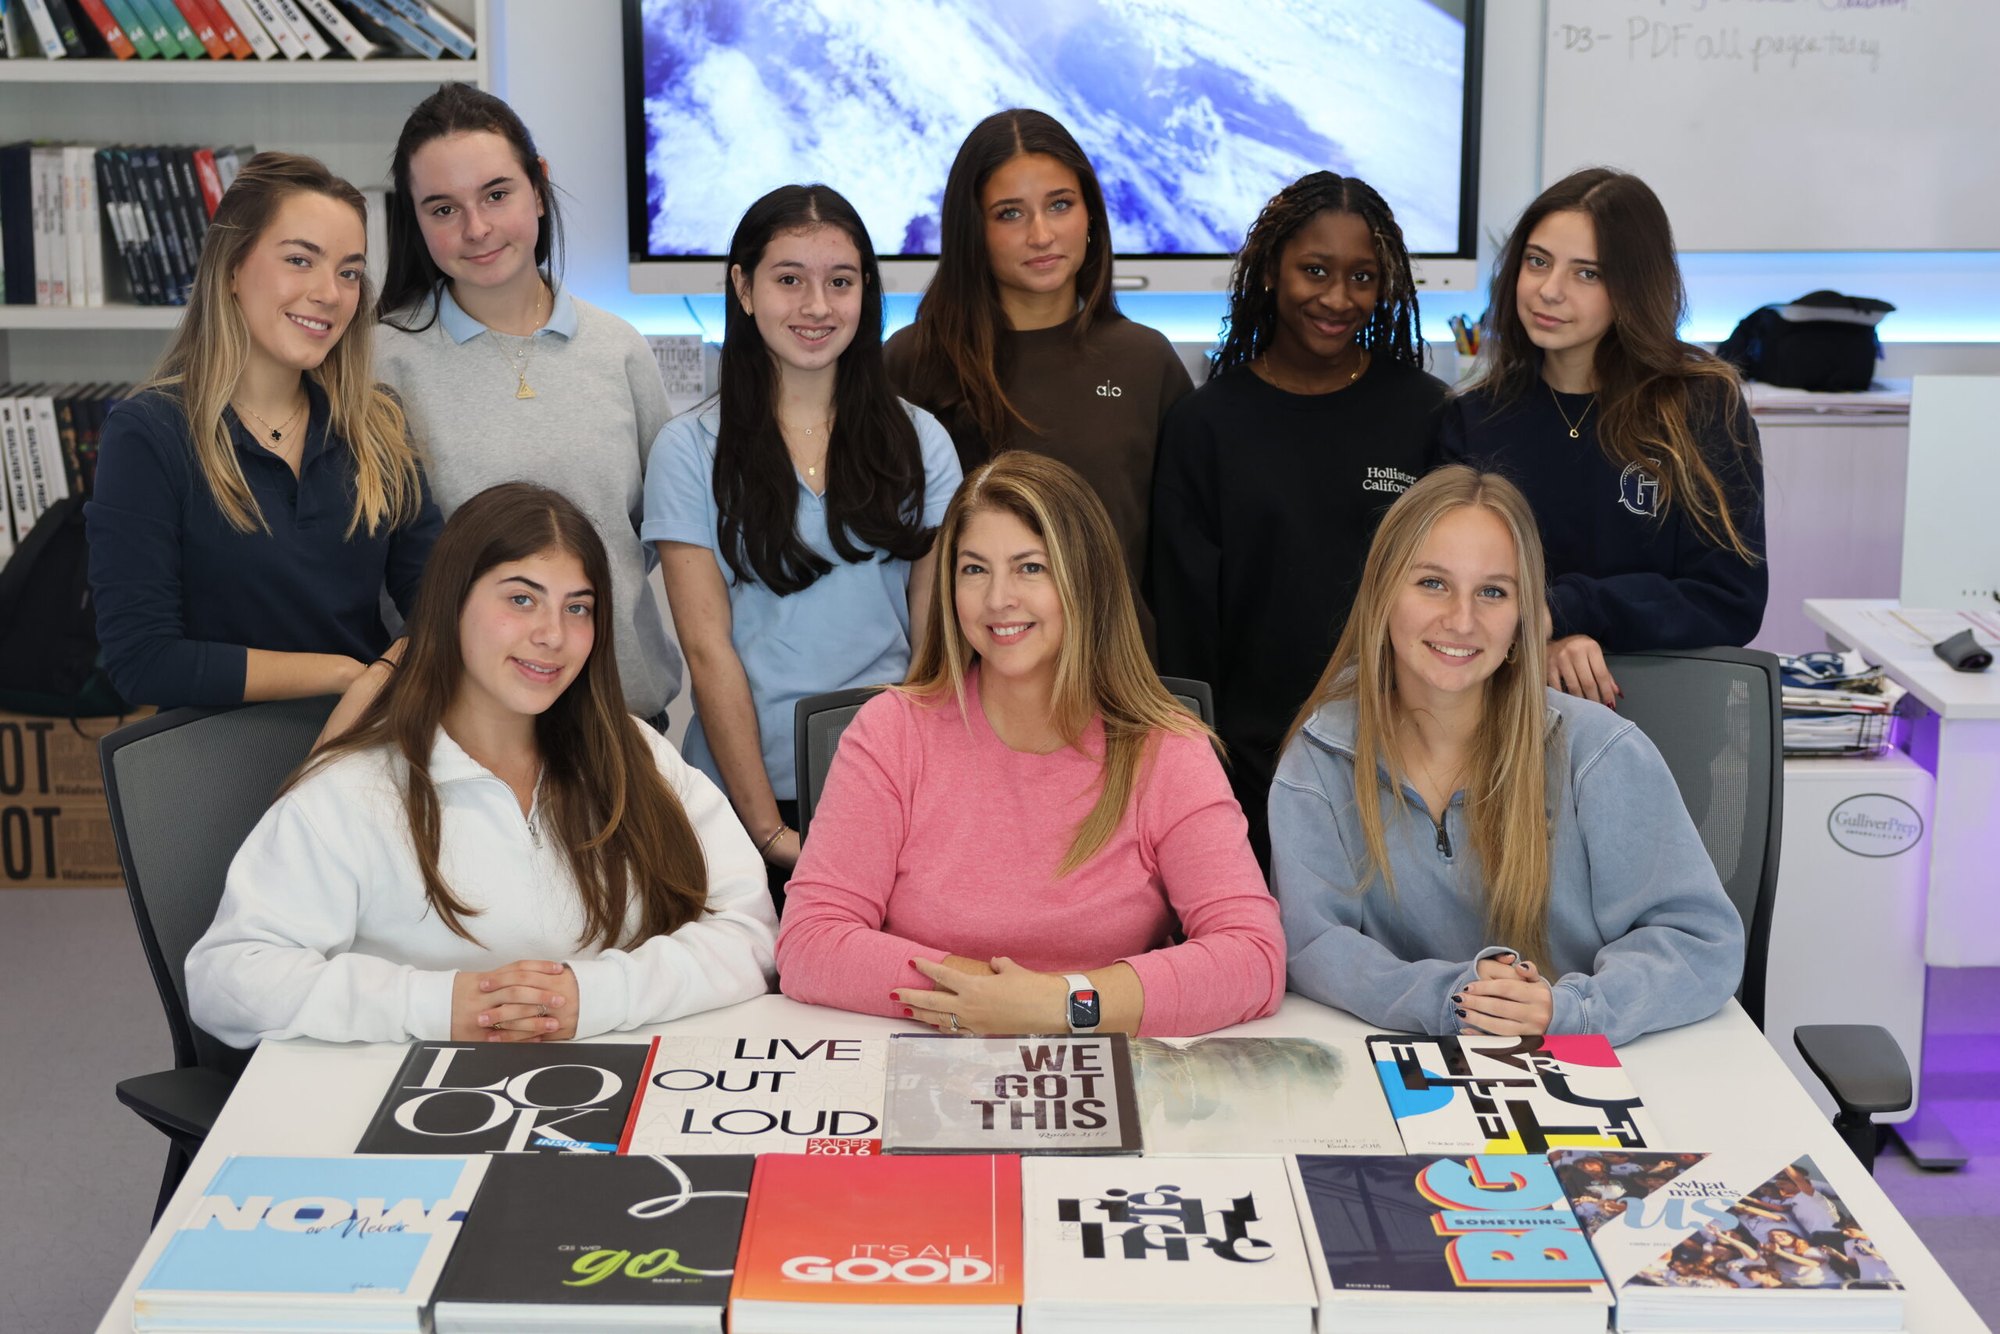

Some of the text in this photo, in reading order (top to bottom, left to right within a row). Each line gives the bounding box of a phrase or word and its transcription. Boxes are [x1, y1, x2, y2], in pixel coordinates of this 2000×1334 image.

[1626, 15, 1695, 61] PDF
[1697, 27, 1744, 60] all
[1362, 480, 1409, 493] Califor
[1367, 467, 1417, 484] Hollister
[734, 1038, 863, 1061] LIVE
[1019, 1044, 1102, 1072] WE
[652, 1069, 796, 1092] OUT
[994, 1073, 1105, 1099] GOT
[681, 1108, 879, 1136] LOUD
[970, 1099, 1108, 1130] THIS
[808, 1145, 872, 1157] 2016
[809, 1138, 872, 1147] RAIDER
[1668, 1187, 1742, 1198] makes
[1673, 1180, 1728, 1190] what
[180, 1195, 466, 1234] NOW
[1454, 1218, 1567, 1226] SOMETHING
[1616, 1197, 1740, 1231] us
[330, 1217, 410, 1239] Never
[852, 1244, 983, 1258] IT'S ALL
[562, 1248, 705, 1287] go
[780, 1256, 993, 1284] GOOD
